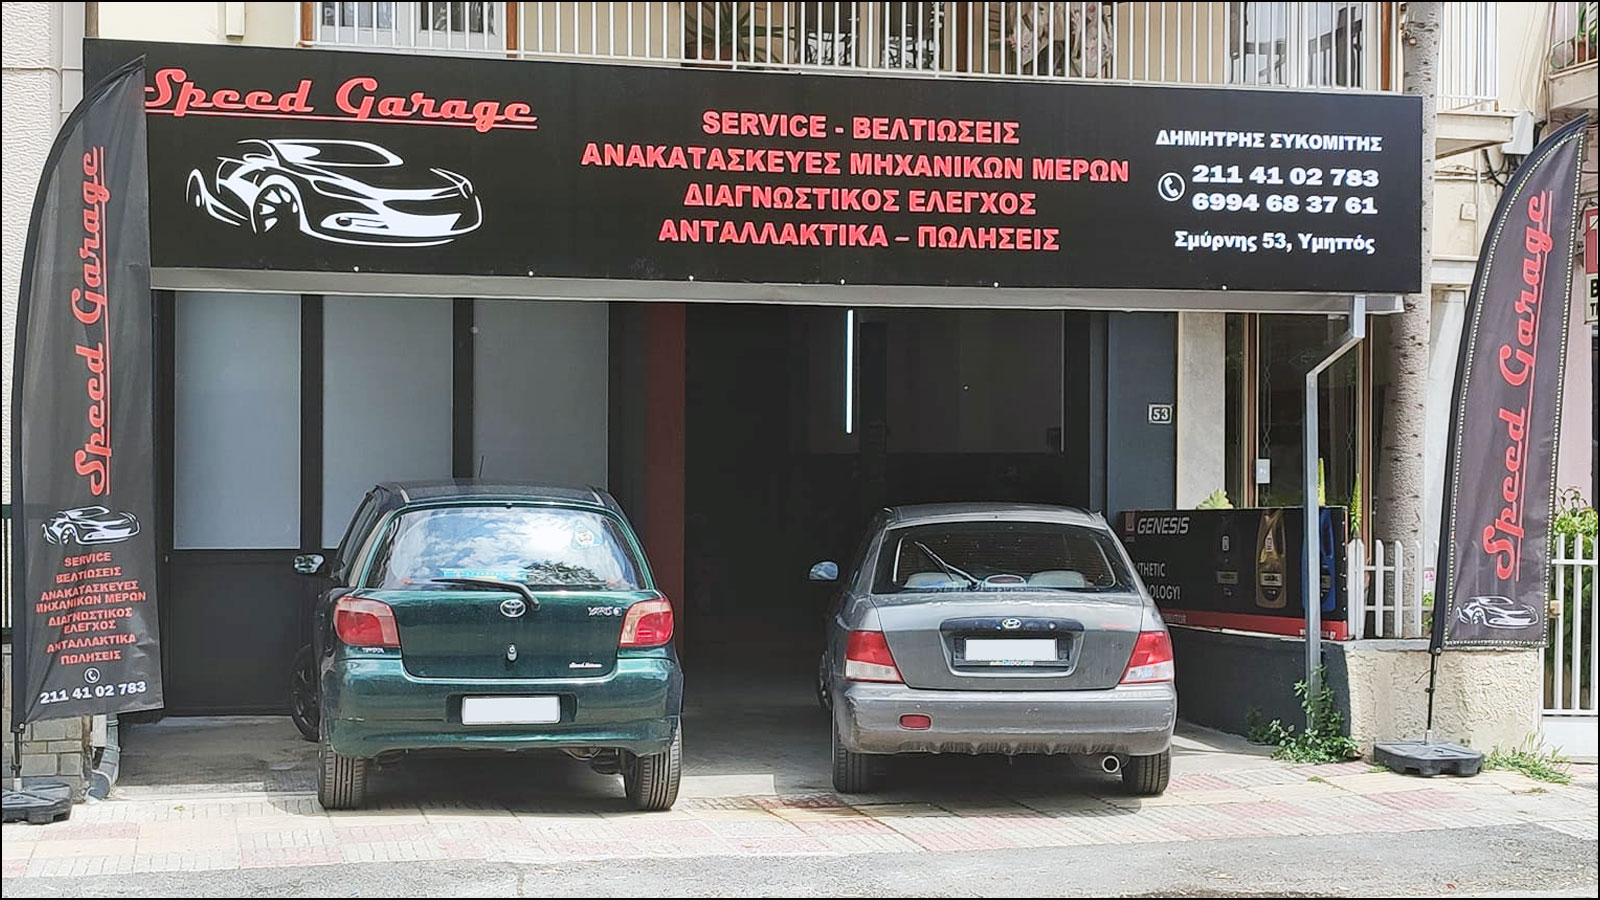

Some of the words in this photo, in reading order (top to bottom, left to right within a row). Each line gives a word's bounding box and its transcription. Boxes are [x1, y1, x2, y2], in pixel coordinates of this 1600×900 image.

[144, 68, 313, 117] Speed
[335, 77, 537, 132] Garage
[702, 110, 826, 139] SERVICE
[852, 117, 1020, 145] ΒΕΛΤΙΩΣΕΙΣ
[1155, 129, 1266, 149] ΔΗΜΗΤΡΗΣ
[1270, 133, 1383, 152] ΣΥΚΟΜΙΤΗΣ
[581, 142, 841, 175] ΑΝΑΚΑΤΑΣΚΕΥΕΣ
[849, 153, 1023, 180] ΜΗΧΑΝΙΚΩΝ
[1032, 157, 1130, 182] ΜΕΡΩΝ
[1192, 165, 1244, 184] 211
[1249, 166, 1284, 185] 41
[1289, 168, 1323, 186] 02
[1330, 169, 1380, 188] 783
[684, 183, 899, 212] ΔΙΑΓΝΩΣΤΙΚΟΣ
[908, 190, 1036, 216] ΕΛΕΓΧΟΣ
[1192, 193, 1260, 212] 6994
[1265, 194, 1300, 213] 68
[1306, 196, 1338, 214] 37
[1344, 197, 1378, 215] 61
[72, 146, 111, 324] Garage
[658, 219, 889, 248] ΑΝΤΑΛΛΑΚΤΙΚΑ
[917, 227, 1060, 252] ΠΩΛΗΣΕΙΣ
[1174, 231, 1258, 253] Σμύρνης
[1262, 233, 1293, 252] 53,
[1499, 190, 1553, 387] Garage
[75, 343, 112, 497] Speed
[1153, 408, 1169, 420] 53
[1482, 407, 1526, 582] Speed
[1137, 517, 1190, 534] GENESIS
[64, 552, 112, 567] SERVICE
[56, 567, 122, 584] ΒΕΛΤΙΩΣΕΙΣ
[41, 580, 140, 601] ΑΝΑΚΑΤΑΣΚΕΥΕΣ
[105, 591, 146, 604] ΜΕΡΩΝ
[48, 607, 133, 627] ΔΙΑΓΝΩΣΤΙΚΟΣ
[63, 620, 117, 634] ΕΛΕΓΧΟΣ
[46, 634, 137, 654] ΑΝΤΑΛΛΑΚΤΙΚΑ
[60, 650, 122, 665] ΠΩΛΗΣΕΙΣ
[40, 689, 70, 705] 211
[72, 686, 92, 700] 41
[95, 684, 115, 698] 02
[118, 681, 147, 696] 783
